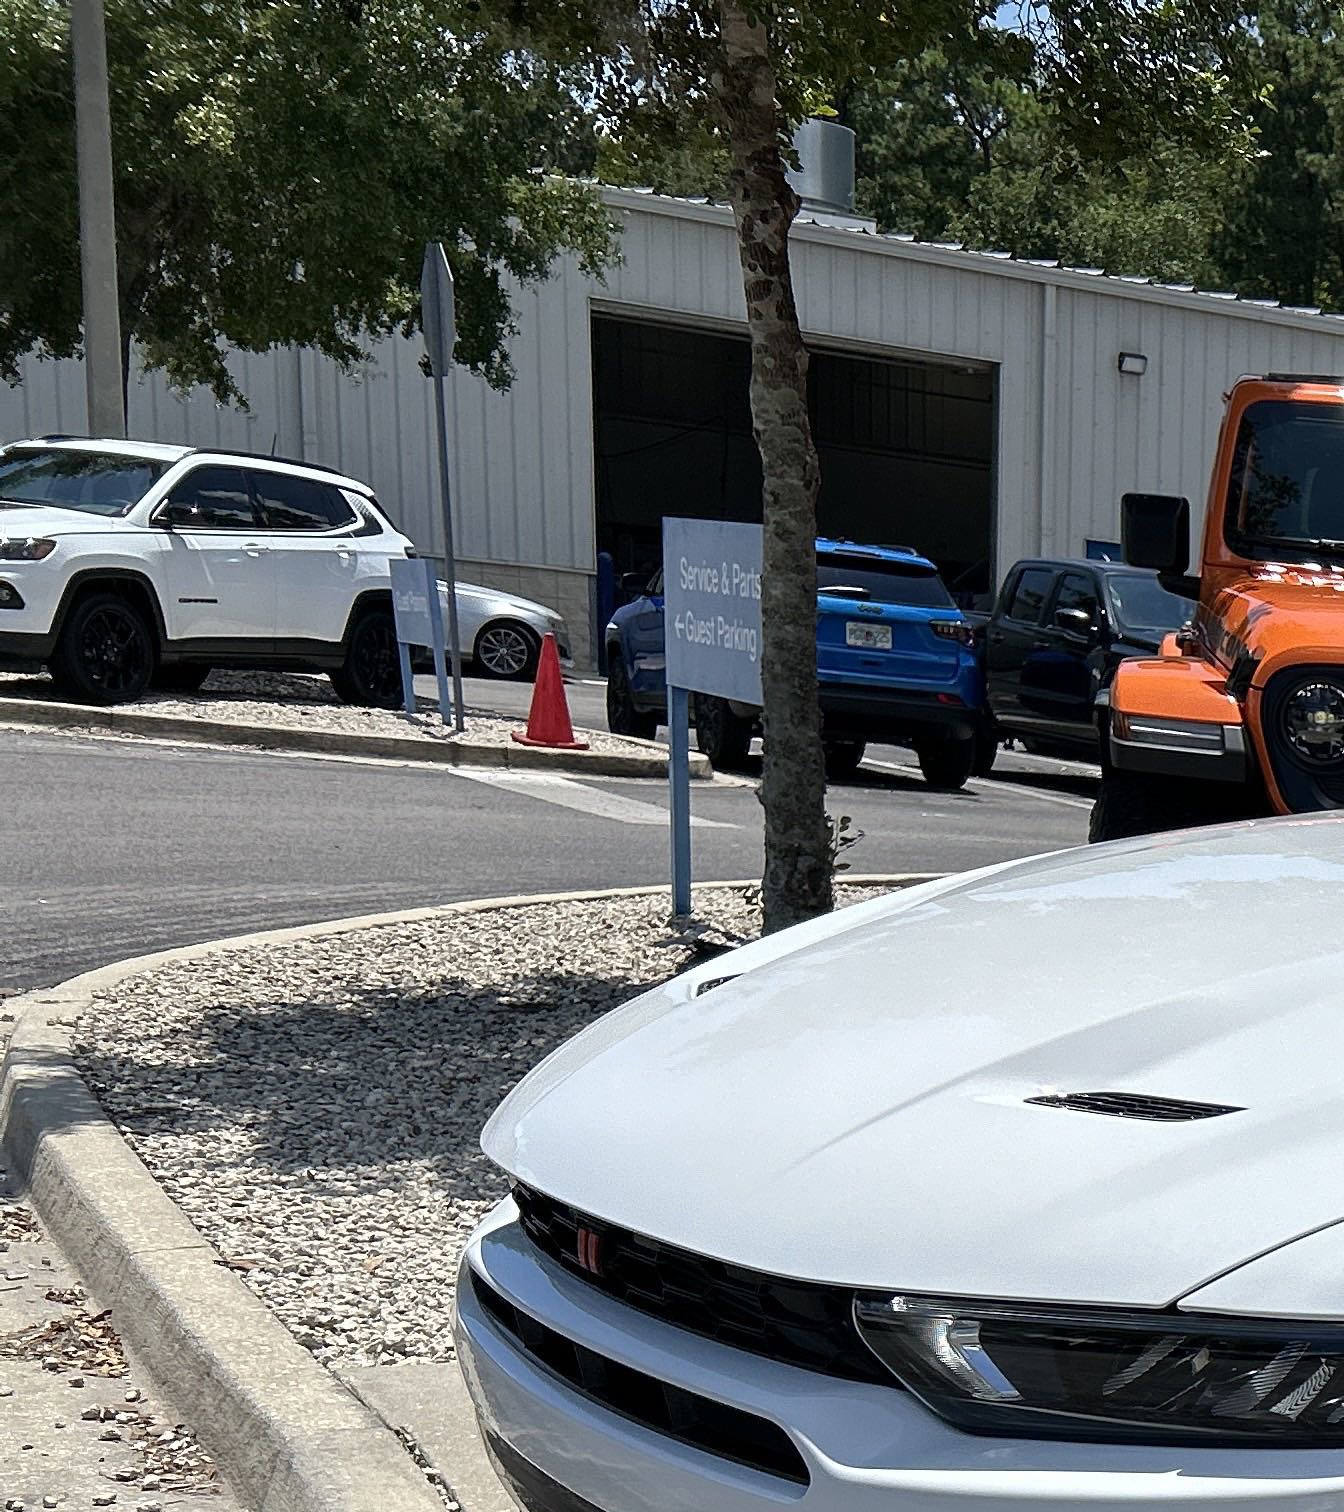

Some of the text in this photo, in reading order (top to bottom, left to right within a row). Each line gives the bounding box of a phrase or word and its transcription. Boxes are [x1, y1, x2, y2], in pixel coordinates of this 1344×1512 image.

[680, 556, 761, 600] Service & Parts
[685, 610, 757, 662] Guest Parking
